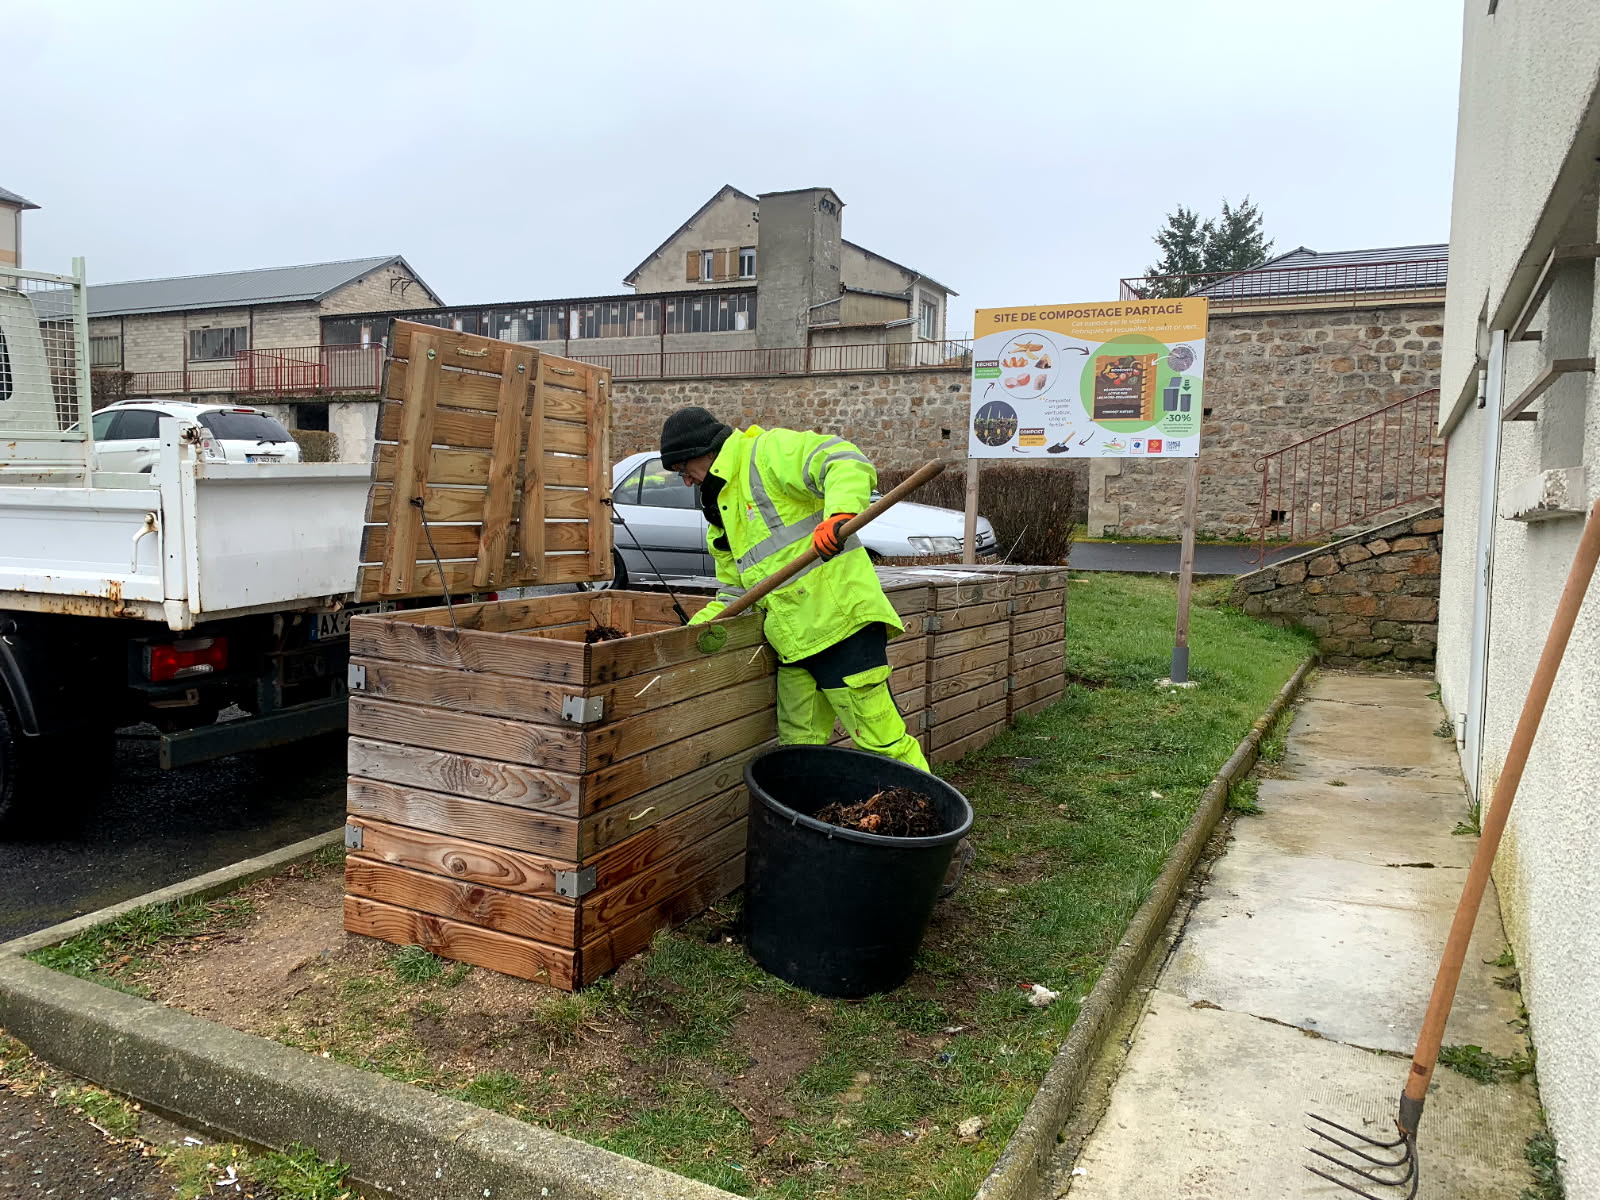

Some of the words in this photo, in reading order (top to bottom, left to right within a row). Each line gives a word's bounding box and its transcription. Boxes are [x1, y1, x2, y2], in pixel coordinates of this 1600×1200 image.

[994, 312, 1018, 323] SITE
[1021, 311, 1036, 321] DE
[1039, 307, 1122, 321] COMPOSTAGE
[1125, 302, 1183, 316] PARTAGÉ
[1165, 414, 1192, 422] -30%
